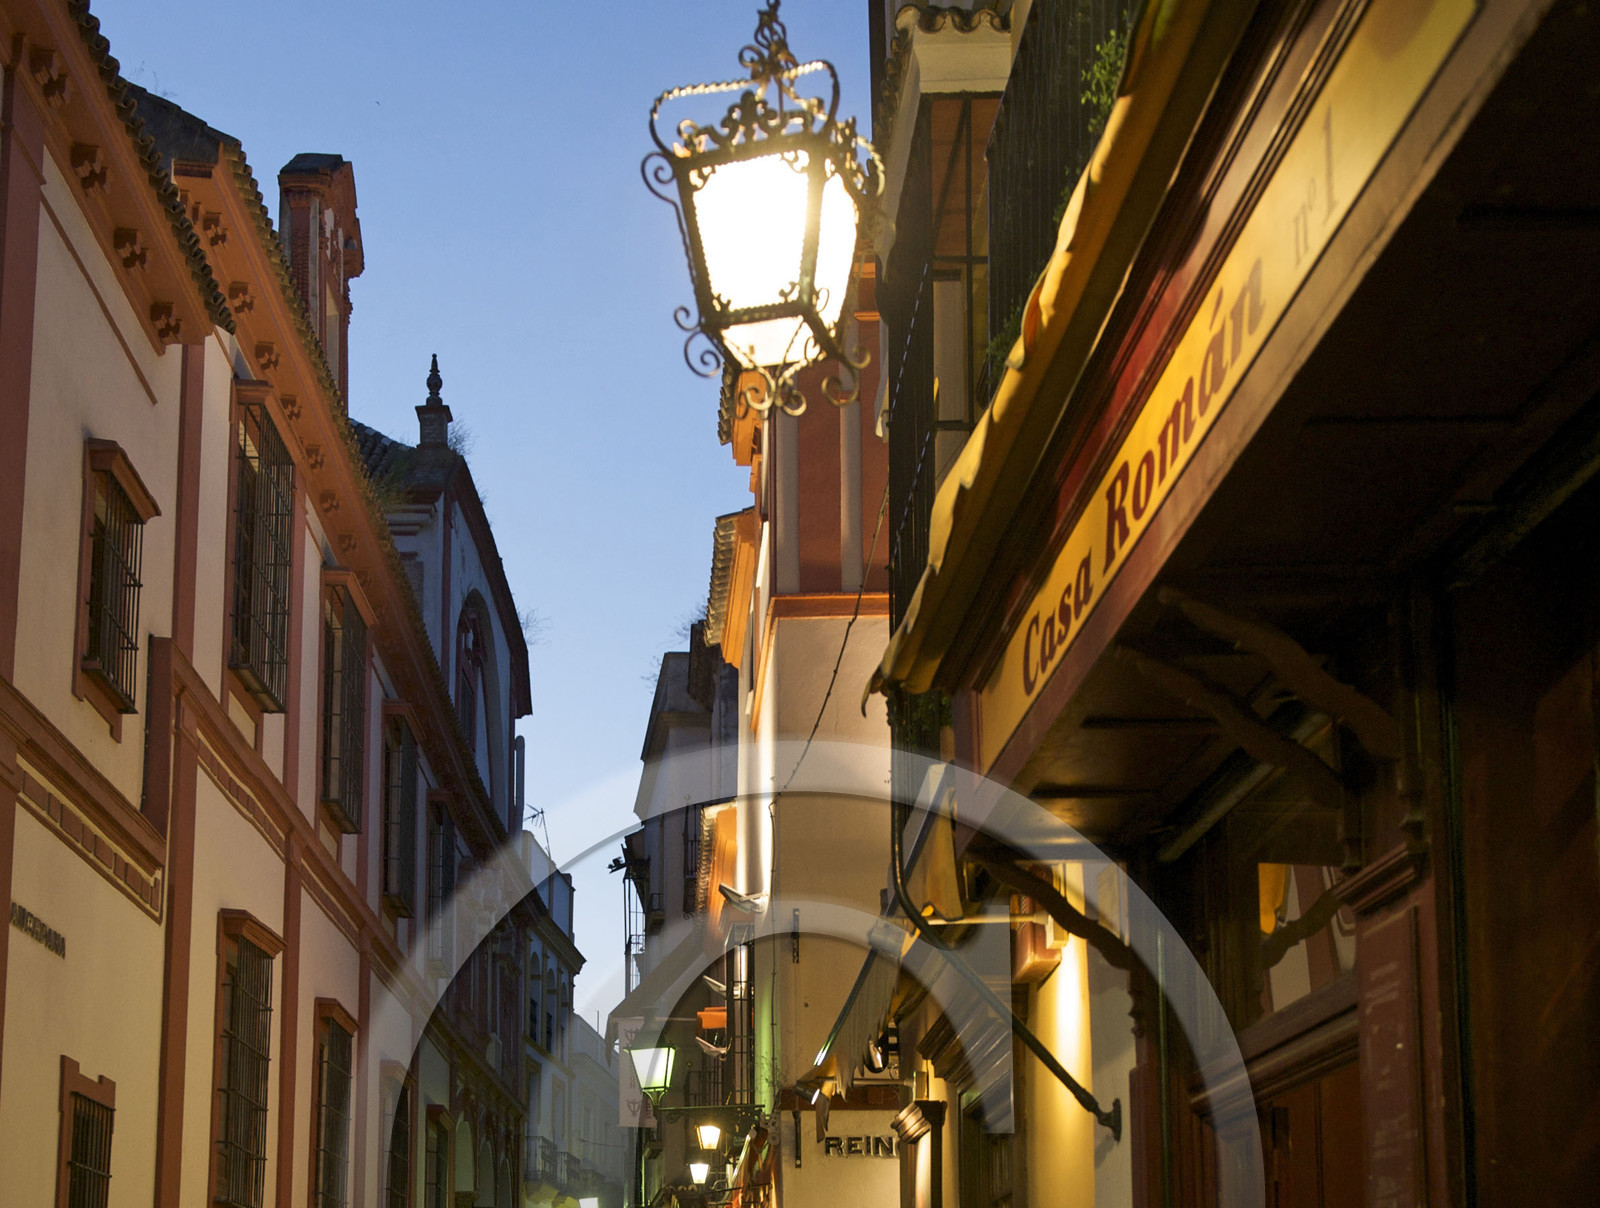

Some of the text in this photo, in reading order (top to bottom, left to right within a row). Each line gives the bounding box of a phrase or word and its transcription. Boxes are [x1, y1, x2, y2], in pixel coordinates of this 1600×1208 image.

[1022, 548, 1094, 697] Casa
[1102, 258, 1266, 575] Román
[825, 1136, 900, 1155] REIN
